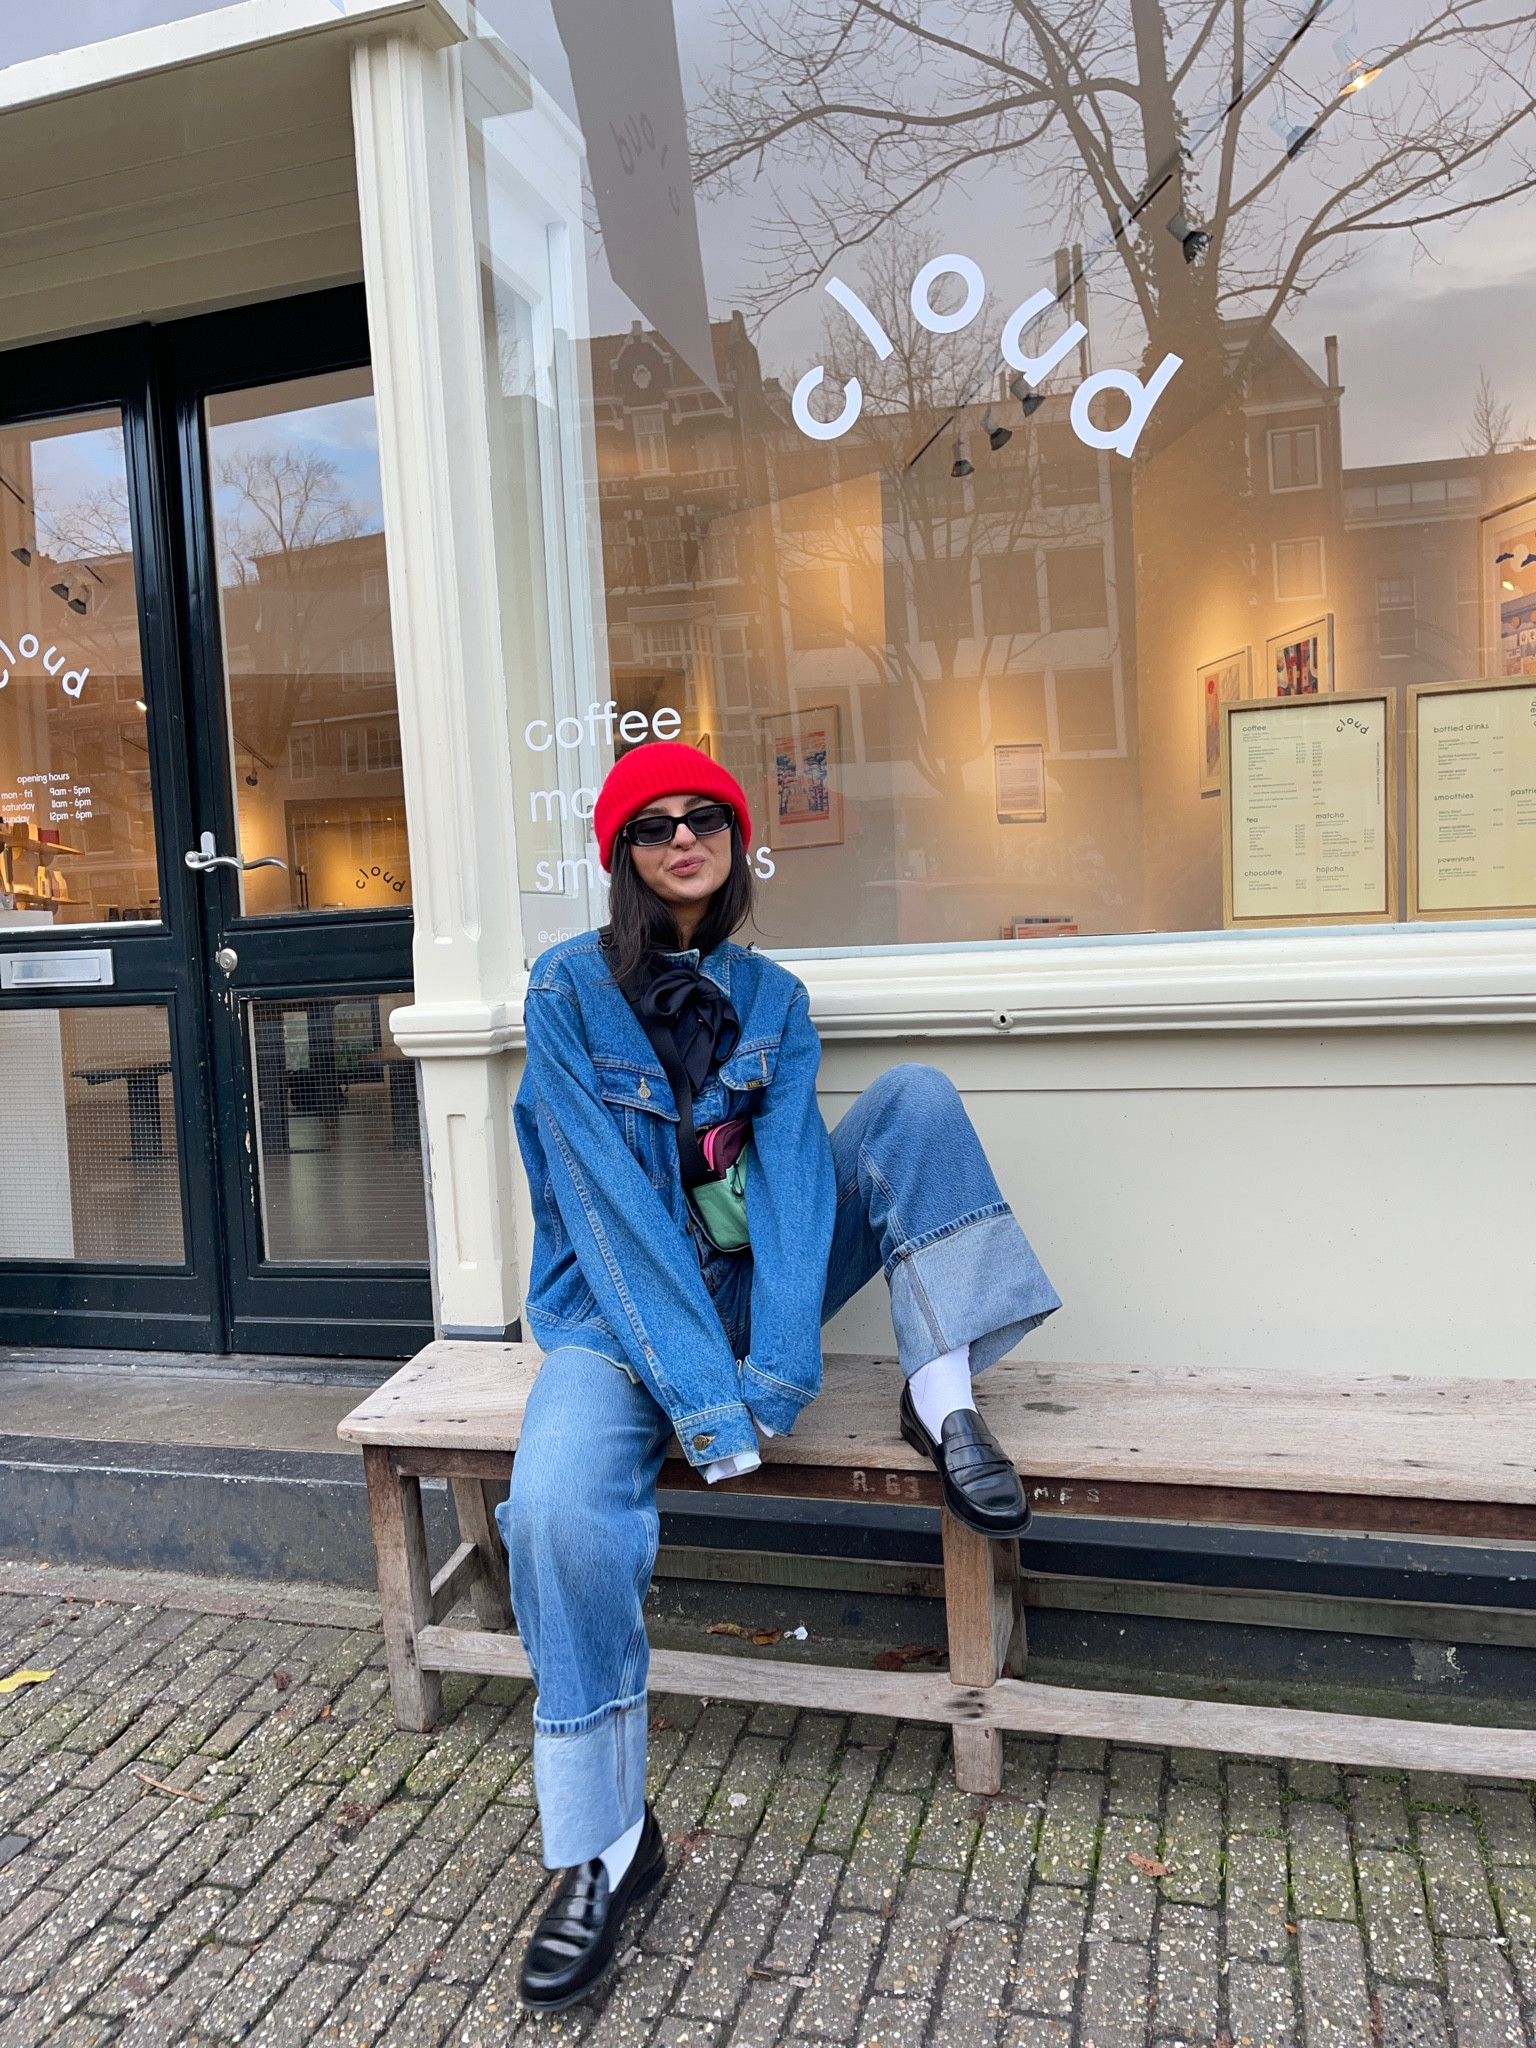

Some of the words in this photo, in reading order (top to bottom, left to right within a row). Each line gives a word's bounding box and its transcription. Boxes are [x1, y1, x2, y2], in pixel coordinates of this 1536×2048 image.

[791, 253, 1184, 459] cloud
[524, 700, 682, 752] coffee
[1242, 724, 1267, 732] coffee
[1336, 717, 1369, 735] cloud
[1434, 723, 1463, 733] bottled
[1466, 722, 1489, 732] drinks
[17, 774, 48, 785] opening
[48, 772, 70, 781] hours
[24, 789, 33, 798] fri
[49, 787, 67, 796] 9am
[73, 785, 91, 796] 5pm
[1434, 792, 1474, 801] smoothies
[1, 802, 35, 812] saturday
[74, 798, 92, 809] 6pm
[2, 815, 30, 825] sunday
[49, 812, 69, 822] 12pm
[75, 810, 93, 821] 6pm
[1246, 816, 1259, 824] tea
[1315, 812, 1345, 820] matcha
[1437, 855, 1475, 864] powershots
[1244, 869, 1283, 877] chocolate
[1316, 865, 1345, 874] hojicha
[355, 866, 406, 893] cloud
